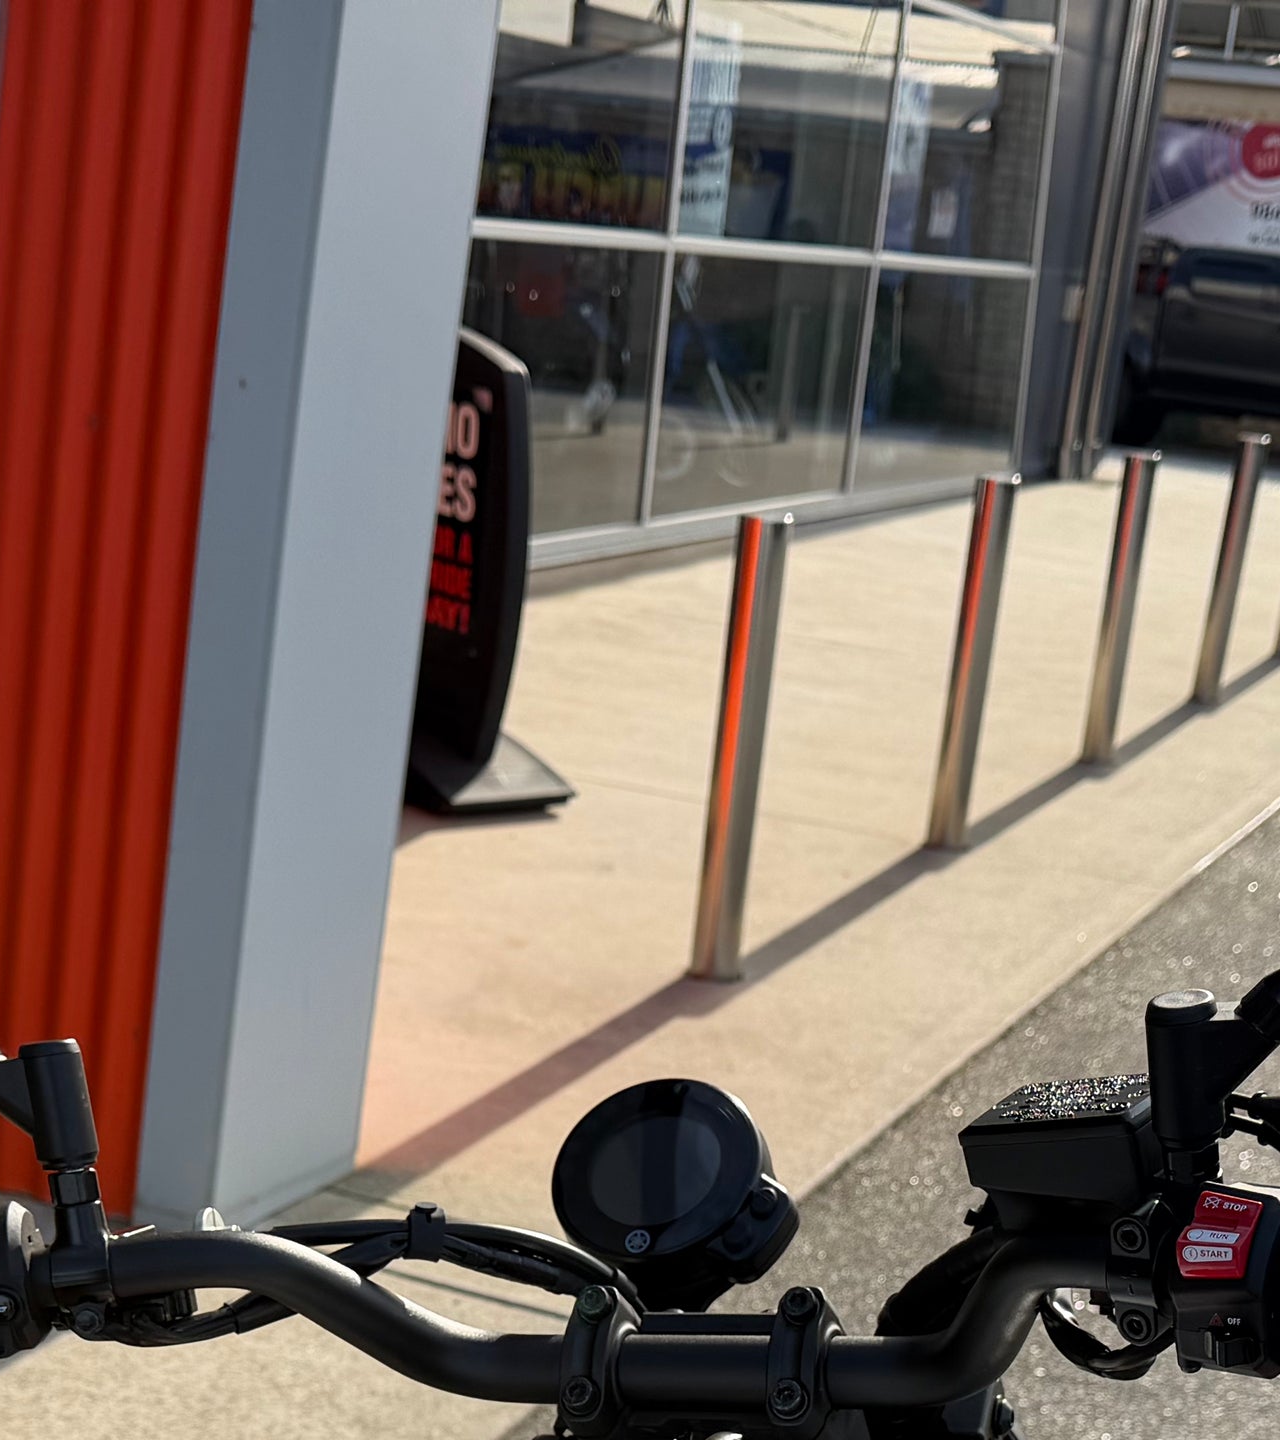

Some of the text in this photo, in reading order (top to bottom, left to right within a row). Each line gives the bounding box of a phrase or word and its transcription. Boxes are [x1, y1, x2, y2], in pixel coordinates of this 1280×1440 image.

[1222, 1201, 1247, 1212] STOP
[1209, 1231, 1230, 1240] RUN
[1200, 1249, 1229, 1259] START
[1227, 1317, 1241, 1326] OFF
